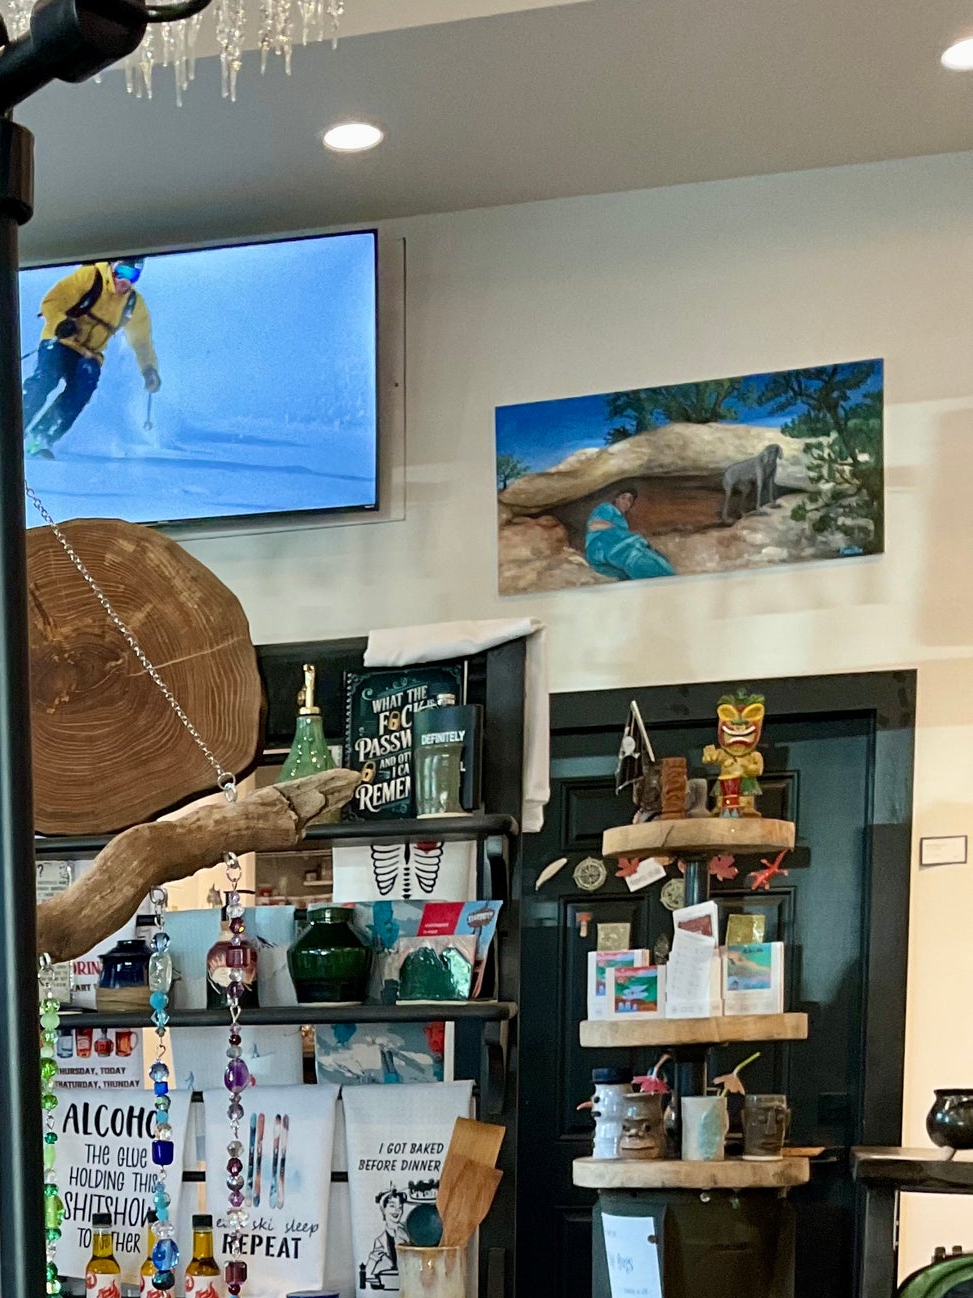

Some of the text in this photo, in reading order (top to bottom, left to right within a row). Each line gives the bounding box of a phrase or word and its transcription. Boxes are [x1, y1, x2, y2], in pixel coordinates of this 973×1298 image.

[372, 685, 427, 713] WHAT THE
[379, 701, 425, 735] FC
[355, 729, 412, 762] PASSW
[421, 731, 465, 745] DEFINITELY
[380, 756, 397, 769] AND
[355, 776, 411, 813] REME
[58, 1067, 126, 1075] HURSDAY, TODAY
[103, 1080, 140, 1088] THUNDAY
[62, 1102, 157, 1139] ALCOHO
[378, 1142, 445, 1154] I GOT BAKED
[358, 1159, 442, 1172] BEFORE DINNER
[69, 1166, 159, 1194] HOLDING THIS
[251, 1217, 275, 1231] ski
[284, 1218, 319, 1238] sleep
[222, 1232, 302, 1260] REPEAT
